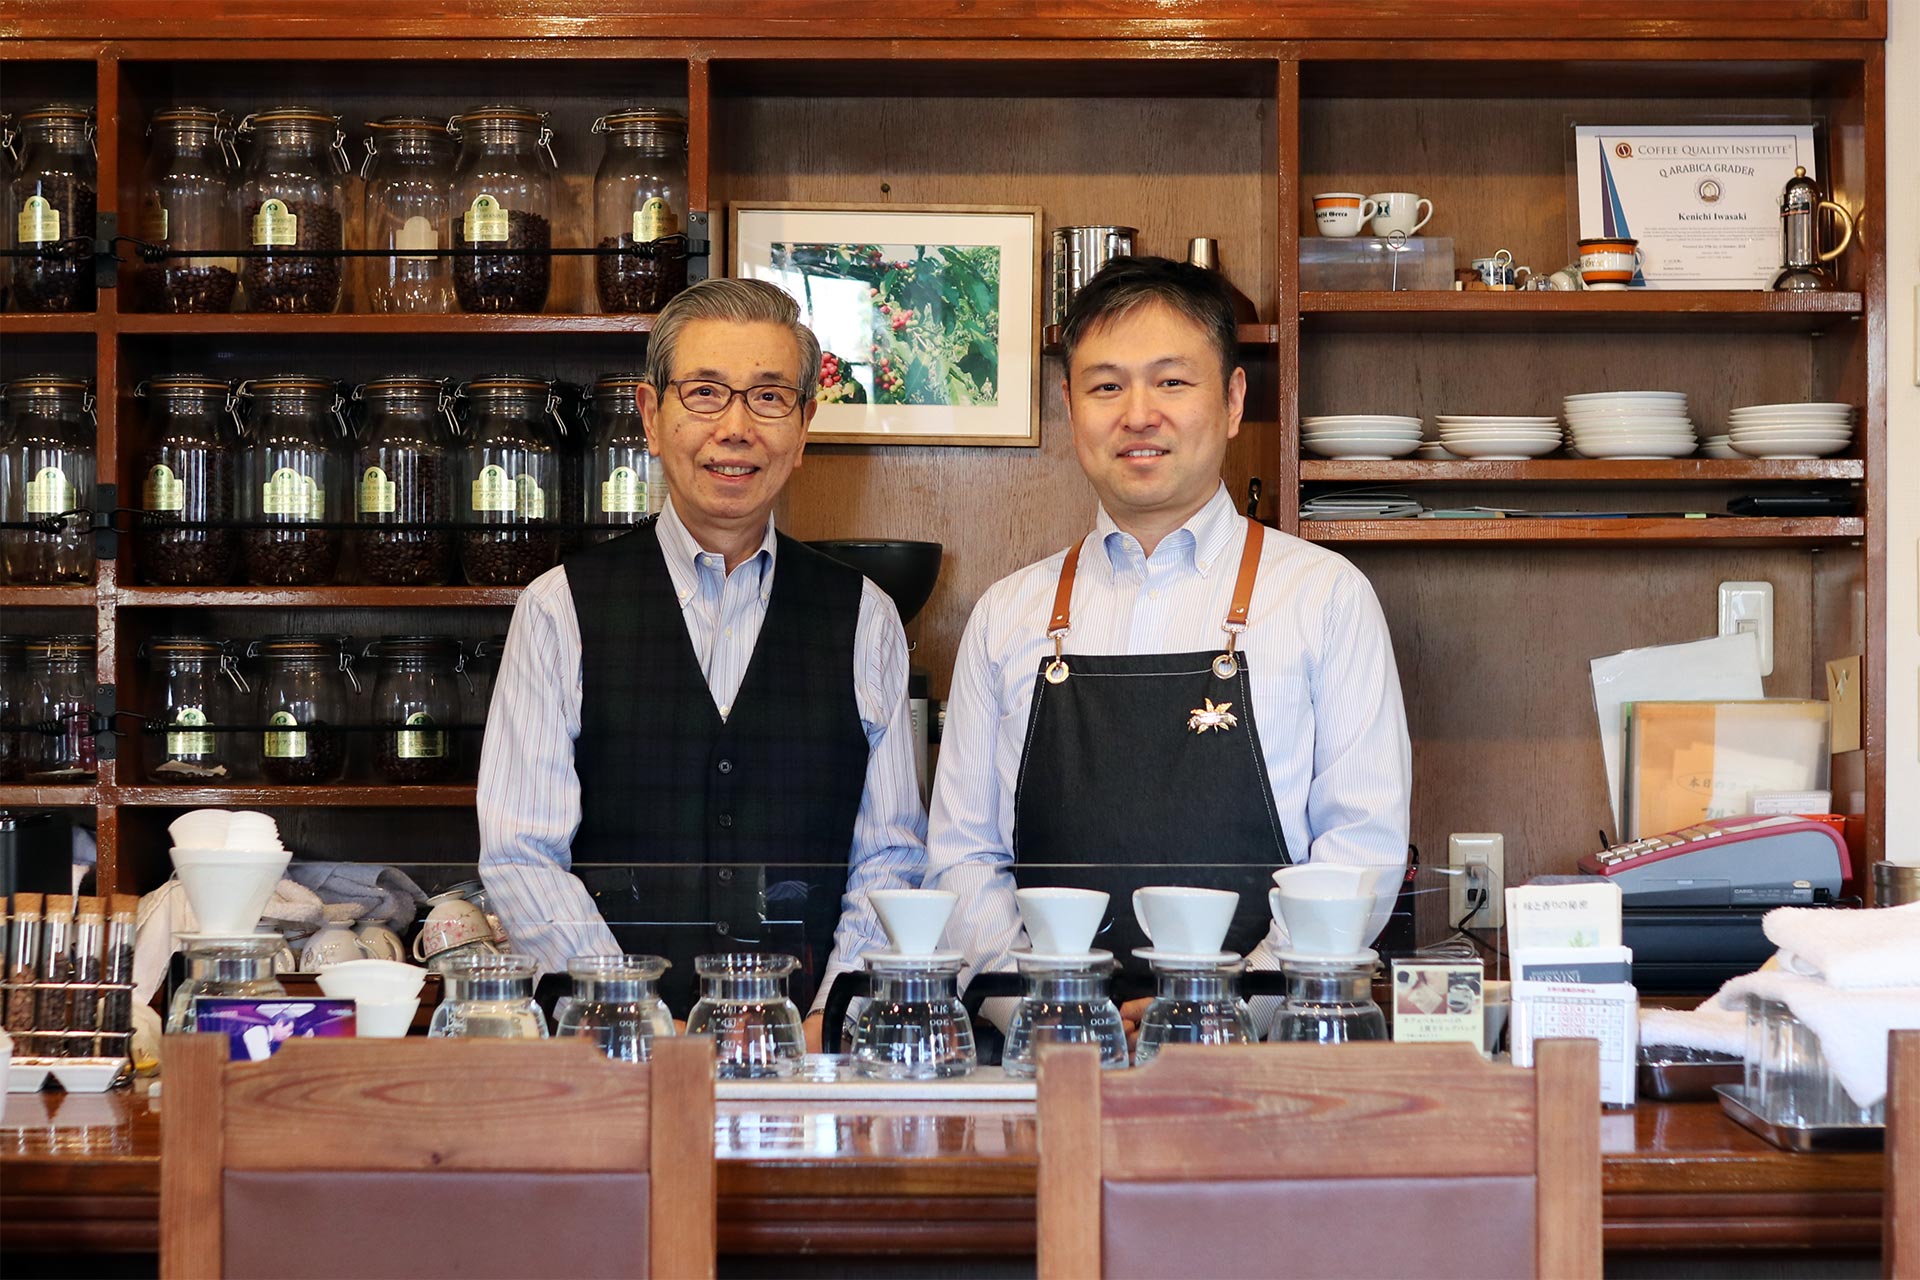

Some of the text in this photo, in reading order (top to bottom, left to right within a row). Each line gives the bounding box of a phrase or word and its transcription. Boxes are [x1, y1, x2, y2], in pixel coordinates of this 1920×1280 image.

[1637, 145, 1678, 155] COFFEE
[1681, 145, 1730, 157] QUALITY
[1659, 163, 1755, 178] Q ARABICA GRADER
[1678, 212, 1748, 221] Kenichi Iwasaki
